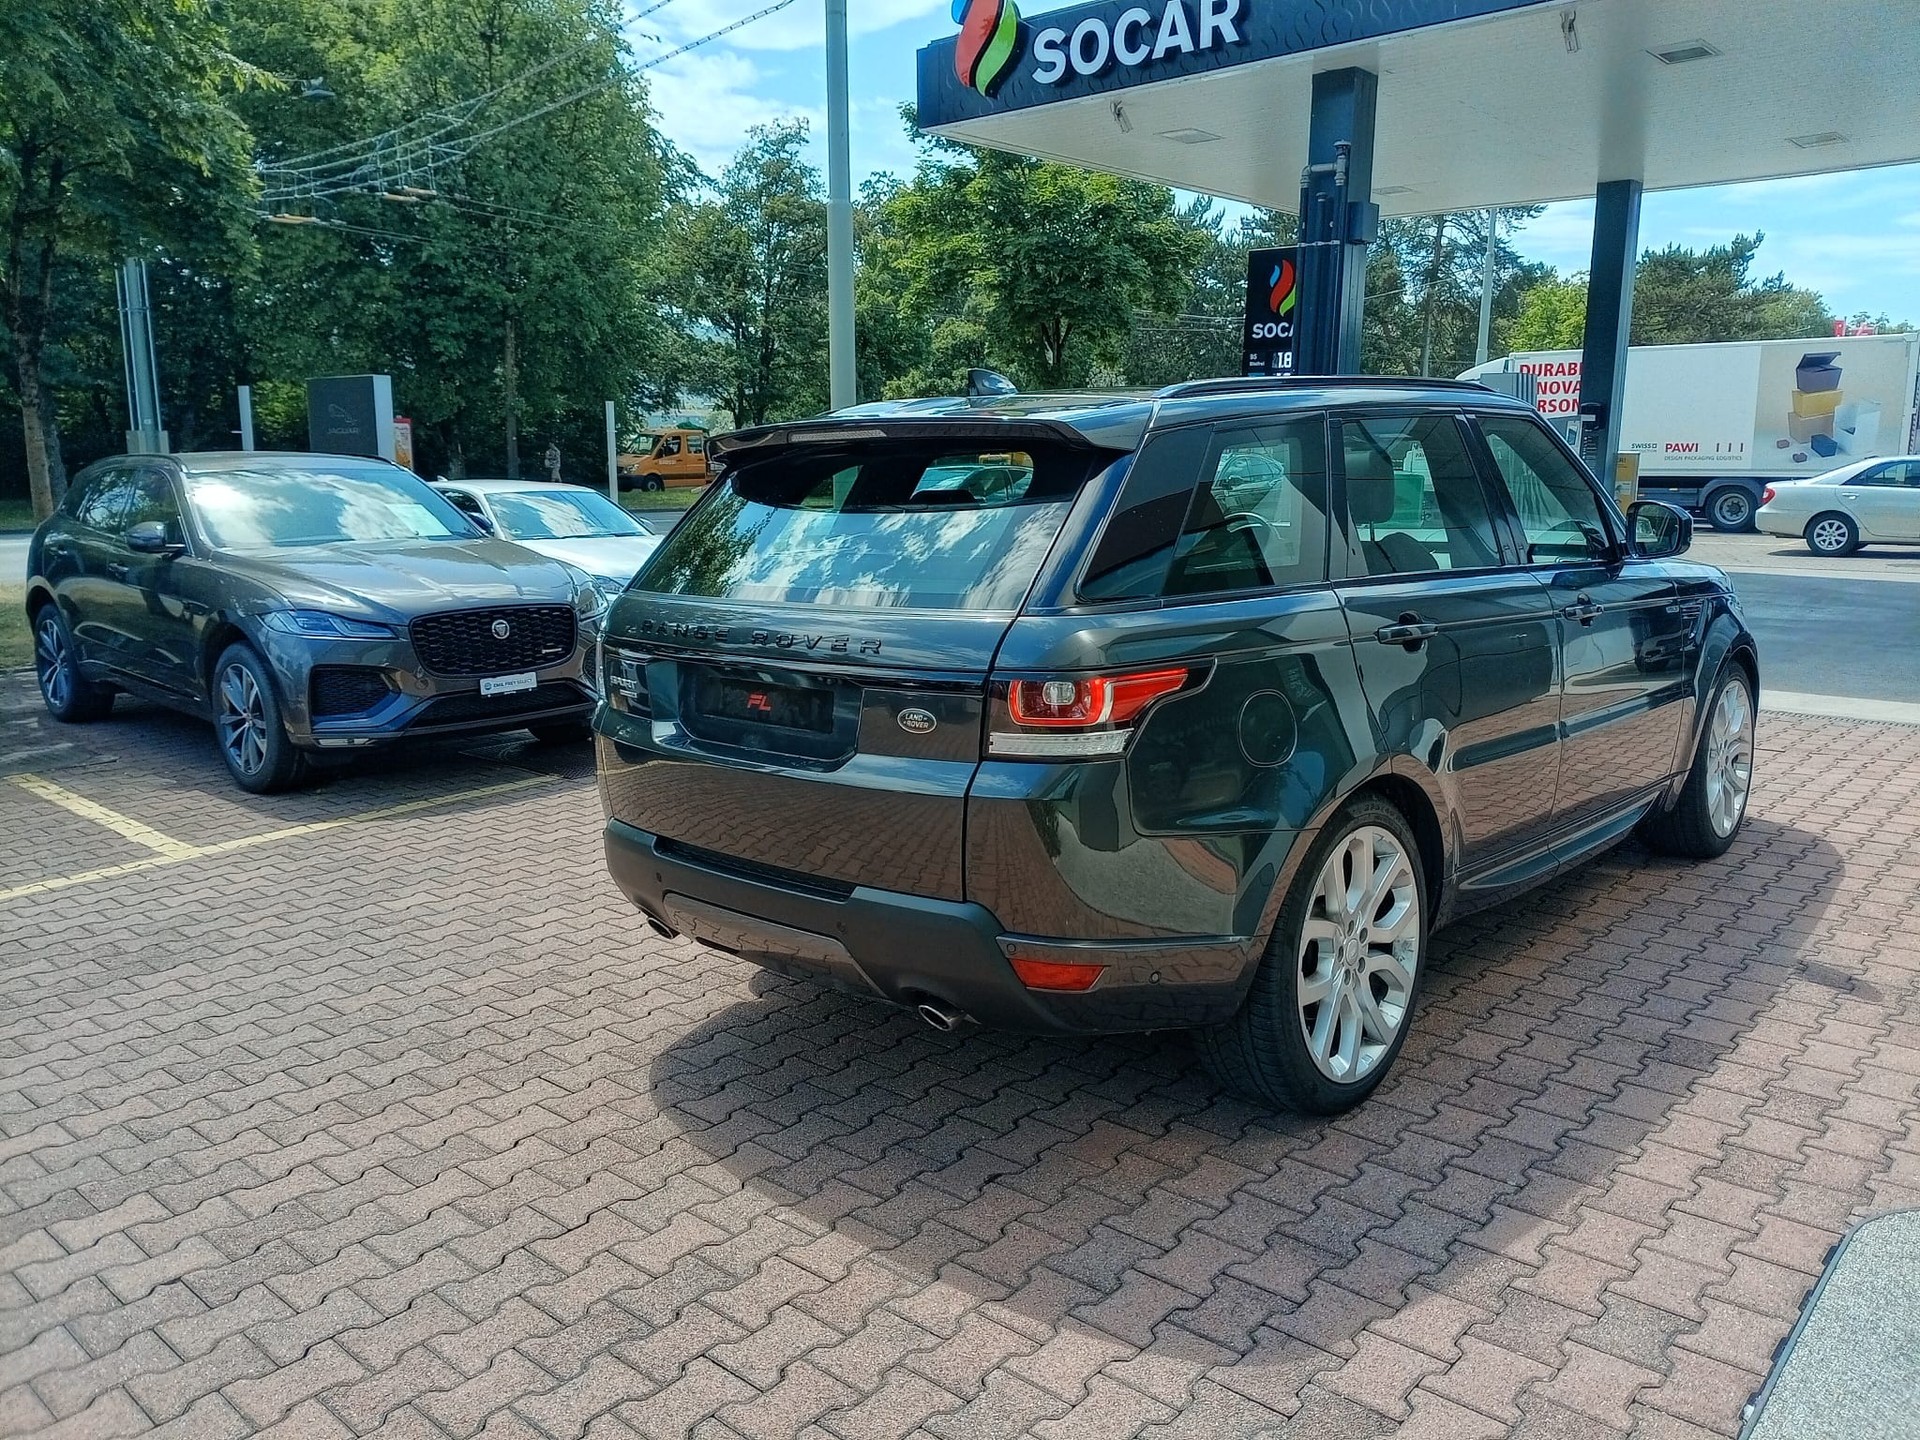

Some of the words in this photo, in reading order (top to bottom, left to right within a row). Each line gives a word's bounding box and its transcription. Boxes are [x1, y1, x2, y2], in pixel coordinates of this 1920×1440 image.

[1031, 0, 1240, 84] SOCAR
[1520, 362, 1583, 377] DURAB
[1665, 443, 1699, 453] PAWI
[640, 619, 731, 643] RANGE
[751, 630, 882, 655] ROVER
[610, 675, 637, 690] SPORT
